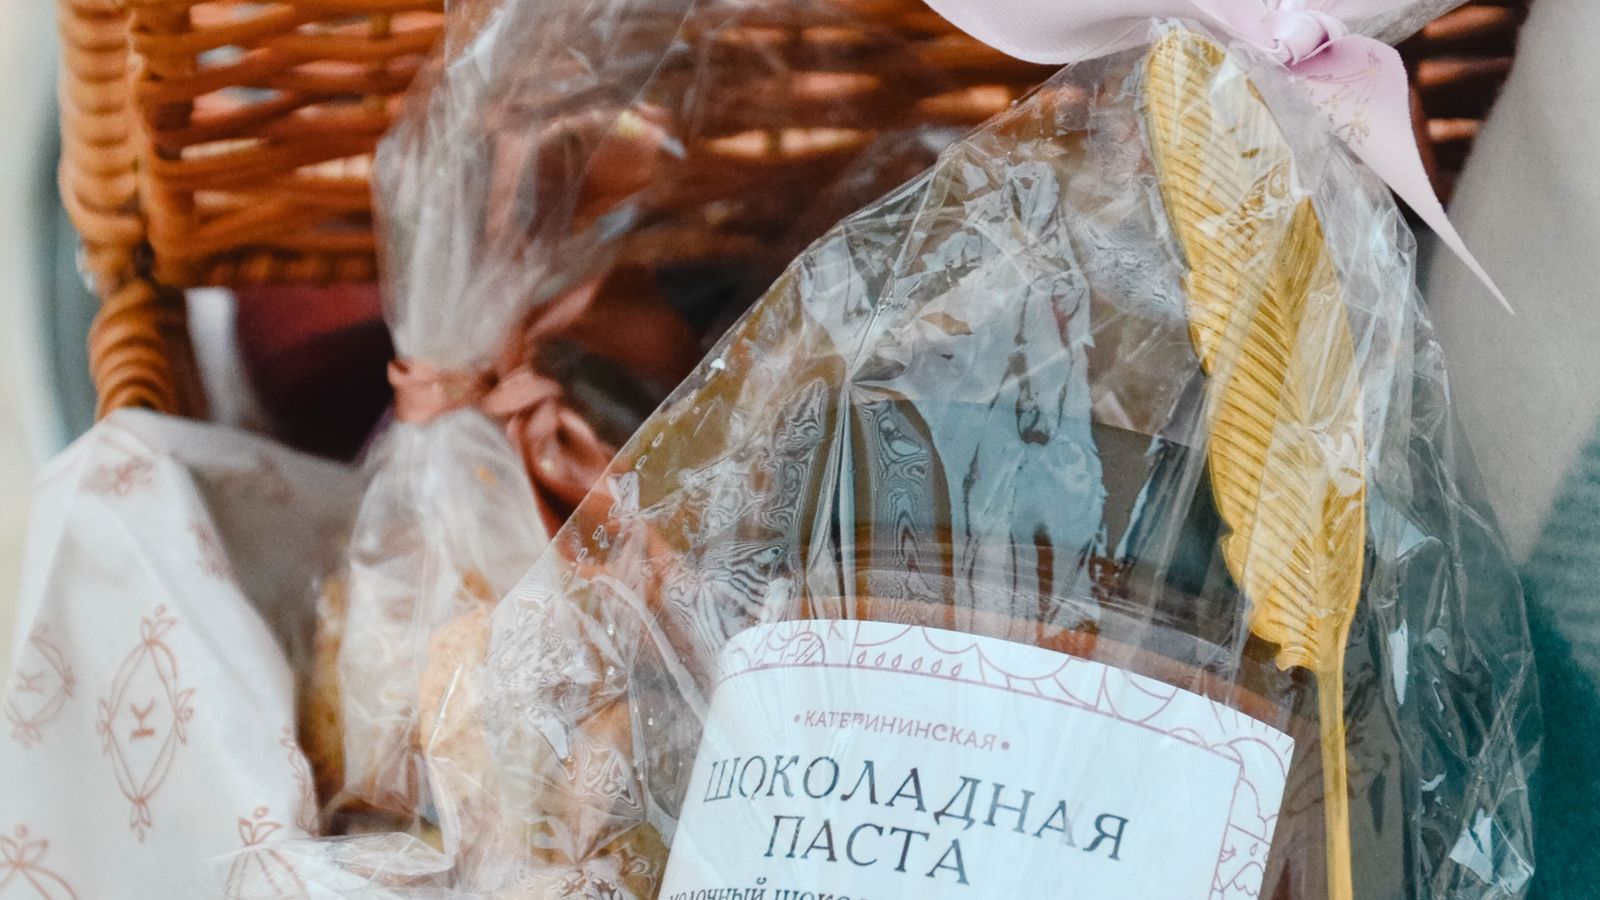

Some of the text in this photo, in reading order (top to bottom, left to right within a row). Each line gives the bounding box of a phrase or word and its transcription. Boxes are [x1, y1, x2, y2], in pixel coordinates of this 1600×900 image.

[804, 709, 998, 751] КАТЕРИНИНСКАЯ
[703, 754, 1130, 861] ШОКОЛАДНАЯ
[763, 815, 970, 885] ПАСТА
